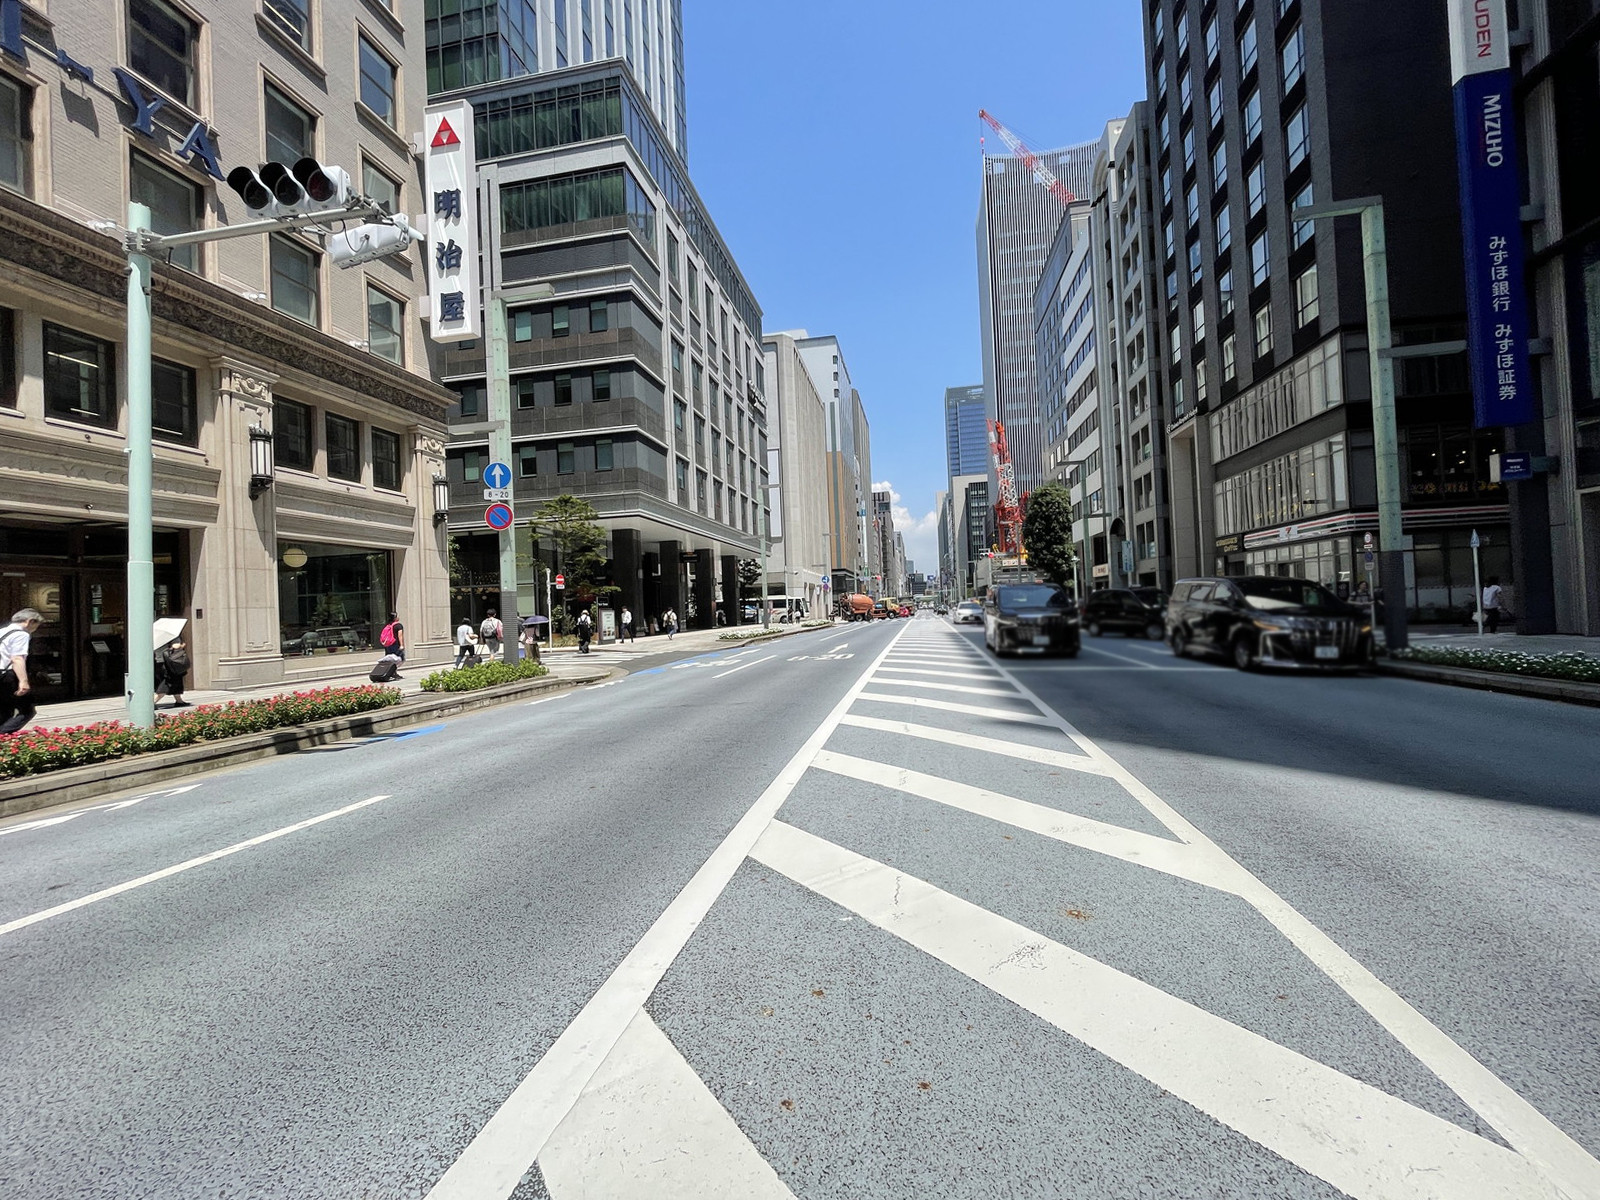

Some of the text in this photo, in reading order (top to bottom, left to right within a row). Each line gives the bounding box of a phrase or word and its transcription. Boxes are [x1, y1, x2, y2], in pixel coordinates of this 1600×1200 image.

[1482, 93, 1504, 168] MIZUHO
[433, 188, 466, 323] 明治屋
[1488, 235, 1517, 401] みずほ銀行 みずほ証券
